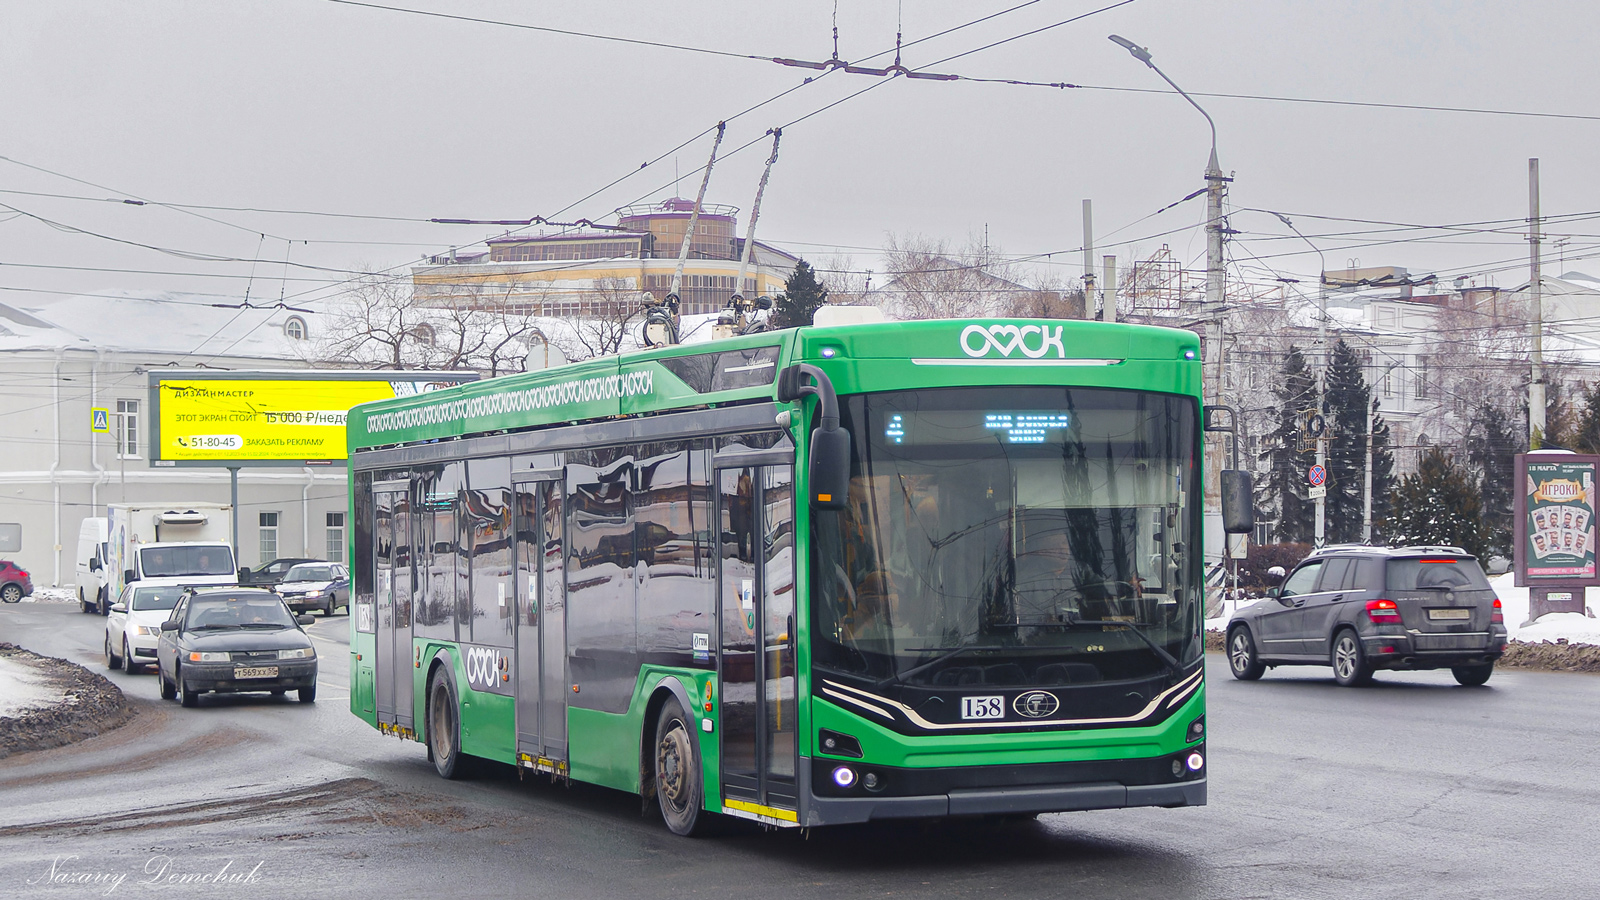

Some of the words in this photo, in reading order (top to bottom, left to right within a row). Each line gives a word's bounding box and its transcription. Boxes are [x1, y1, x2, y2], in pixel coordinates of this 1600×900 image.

[175, 390, 254, 399] ДИЗАЙНМАСТЕР
[176, 414, 198, 422] ЭТОТ
[199, 414, 227, 422] ЭКРАН
[228, 414, 257, 422] СТОИТ
[191, 437, 236, 447] 51-80-45
[245, 438, 285, 446] ЗАКАЗАТЬ
[286, 438, 324, 446] РЕКЛАМУ
[1541, 484, 1578, 495] ИГРОКИ
[964, 698, 1001, 717] 158
